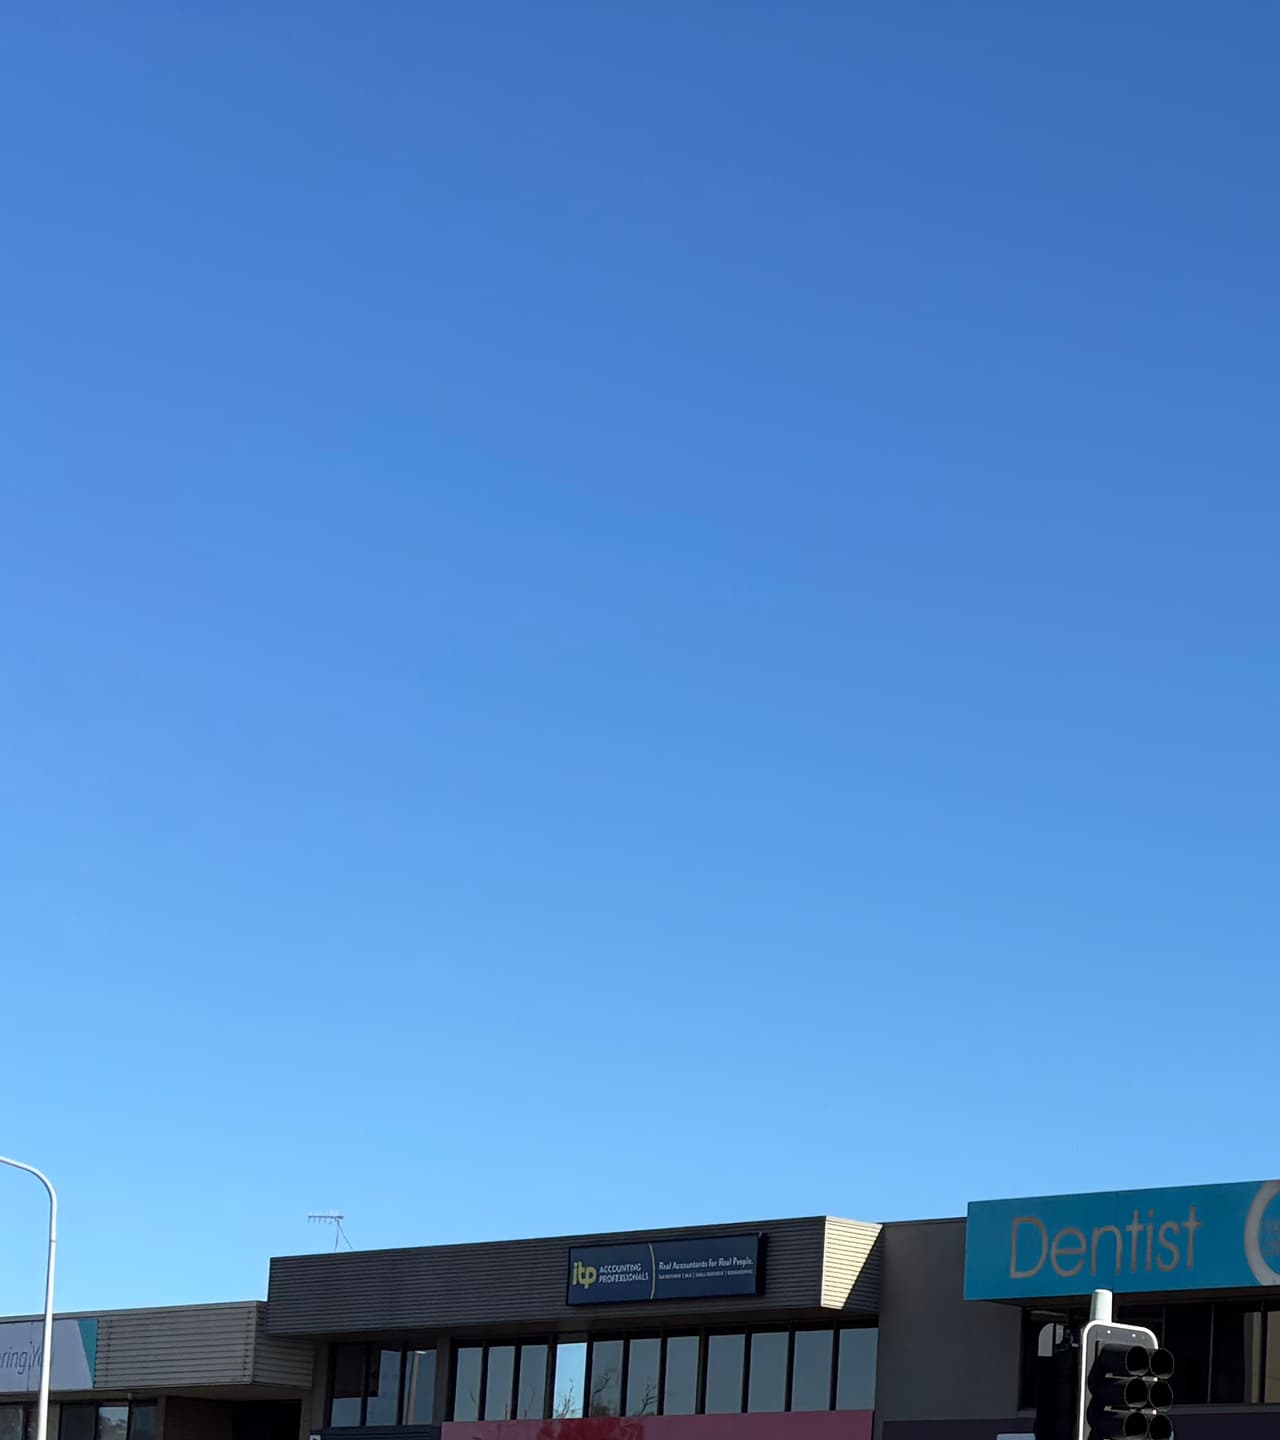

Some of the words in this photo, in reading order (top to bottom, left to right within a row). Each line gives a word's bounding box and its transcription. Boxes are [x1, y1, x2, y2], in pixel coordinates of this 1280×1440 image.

[1009, 1204, 1202, 1279] Dentist
[571, 1261, 597, 1289] itp
[599, 1272, 649, 1283] PROFESSIONALS
[600, 1263, 642, 1274] ACCOUNTING
